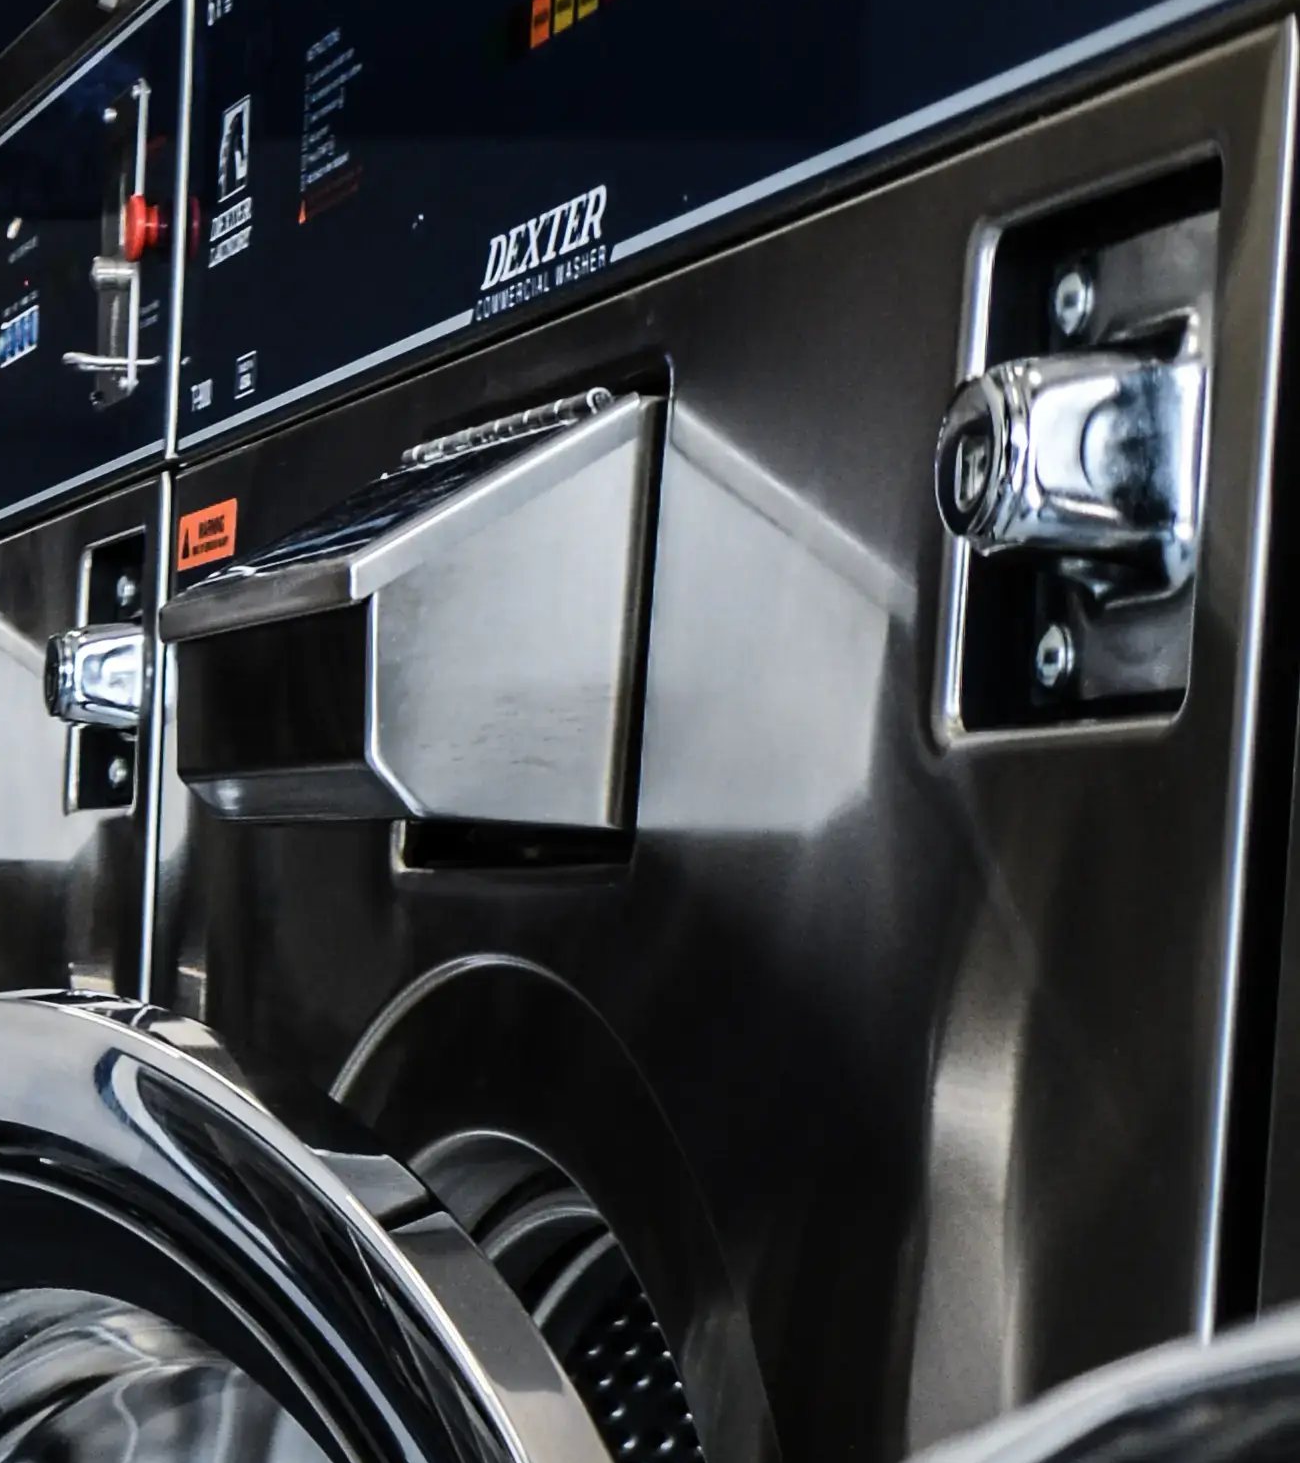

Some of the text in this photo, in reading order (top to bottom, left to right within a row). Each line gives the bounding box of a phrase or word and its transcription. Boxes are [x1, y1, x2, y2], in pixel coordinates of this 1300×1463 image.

[474, 244, 608, 322] COMMERCIAL WASHER
[480, 184, 608, 292] DEXTER
